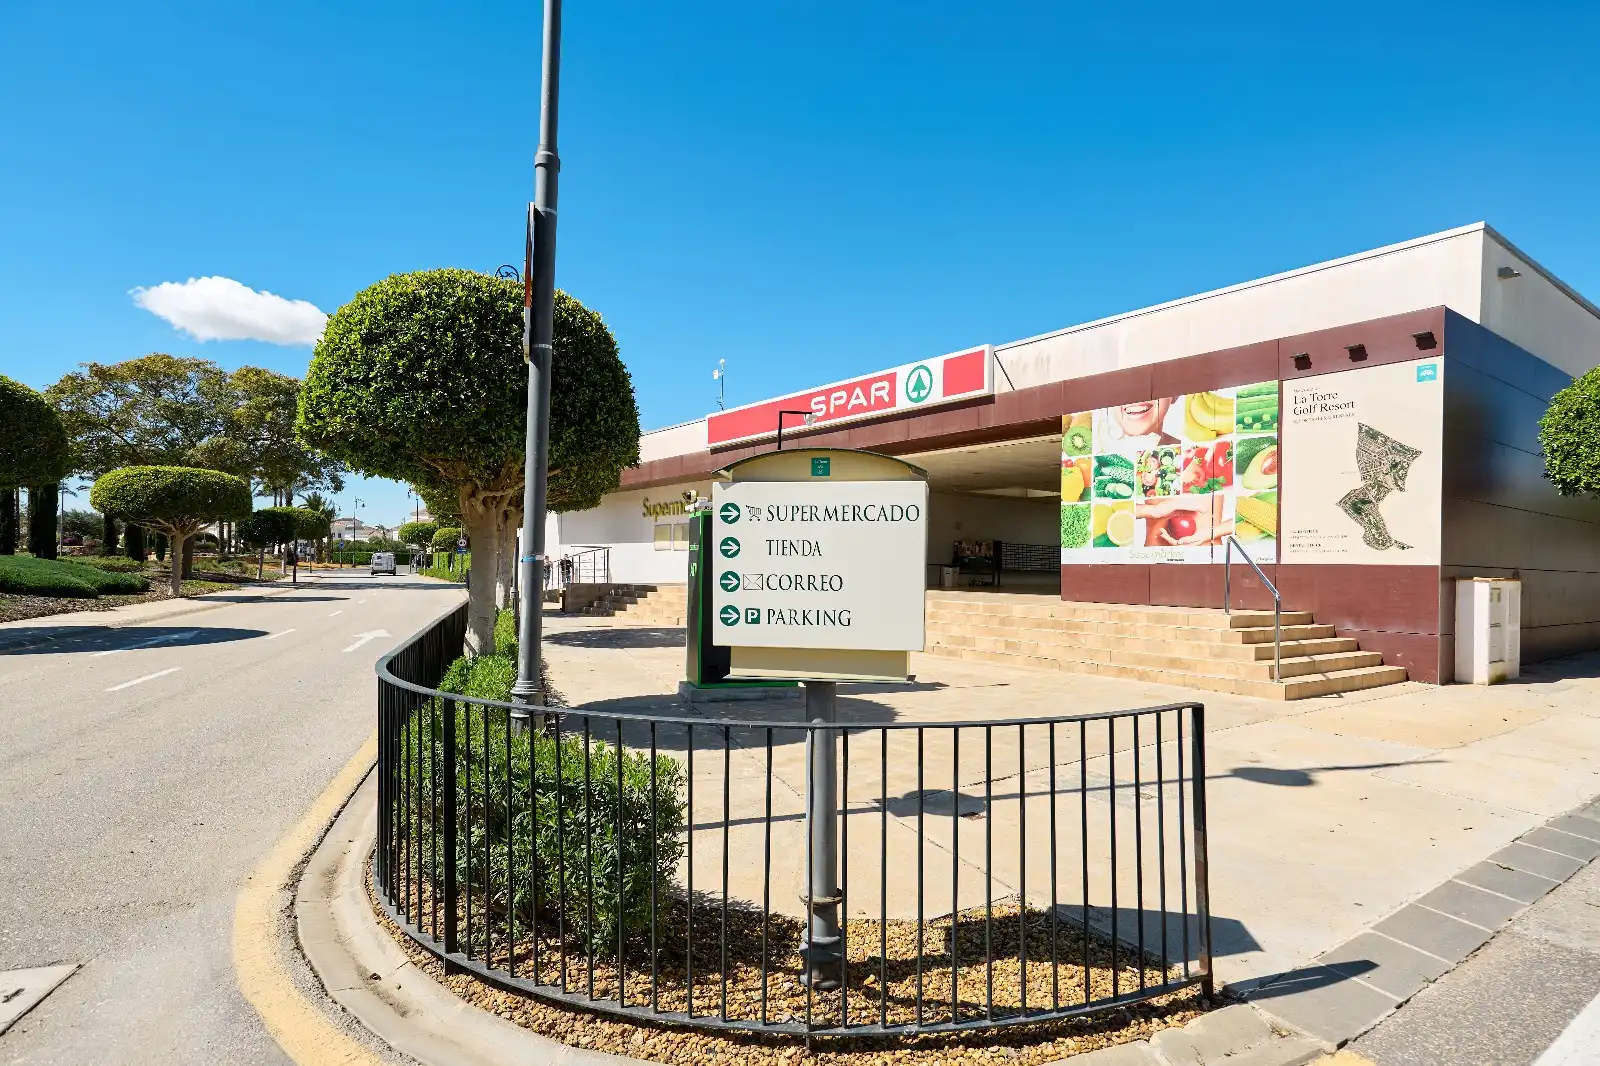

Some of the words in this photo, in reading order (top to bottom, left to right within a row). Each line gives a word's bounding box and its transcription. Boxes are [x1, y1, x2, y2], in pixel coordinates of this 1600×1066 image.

[810, 380, 890, 417] SPAR
[1294, 395, 1307, 405] La
[1309, 392, 1338, 402] Torre
[1293, 403, 1318, 416] Golf
[1319, 401, 1355, 412] Resort
[766, 504, 920, 522] SUPERMERCADO
[765, 539, 823, 557] TIENDA
[766, 574, 844, 592] CORREO
[747, 609, 759, 623] P
[766, 608, 852, 627] PARKING
